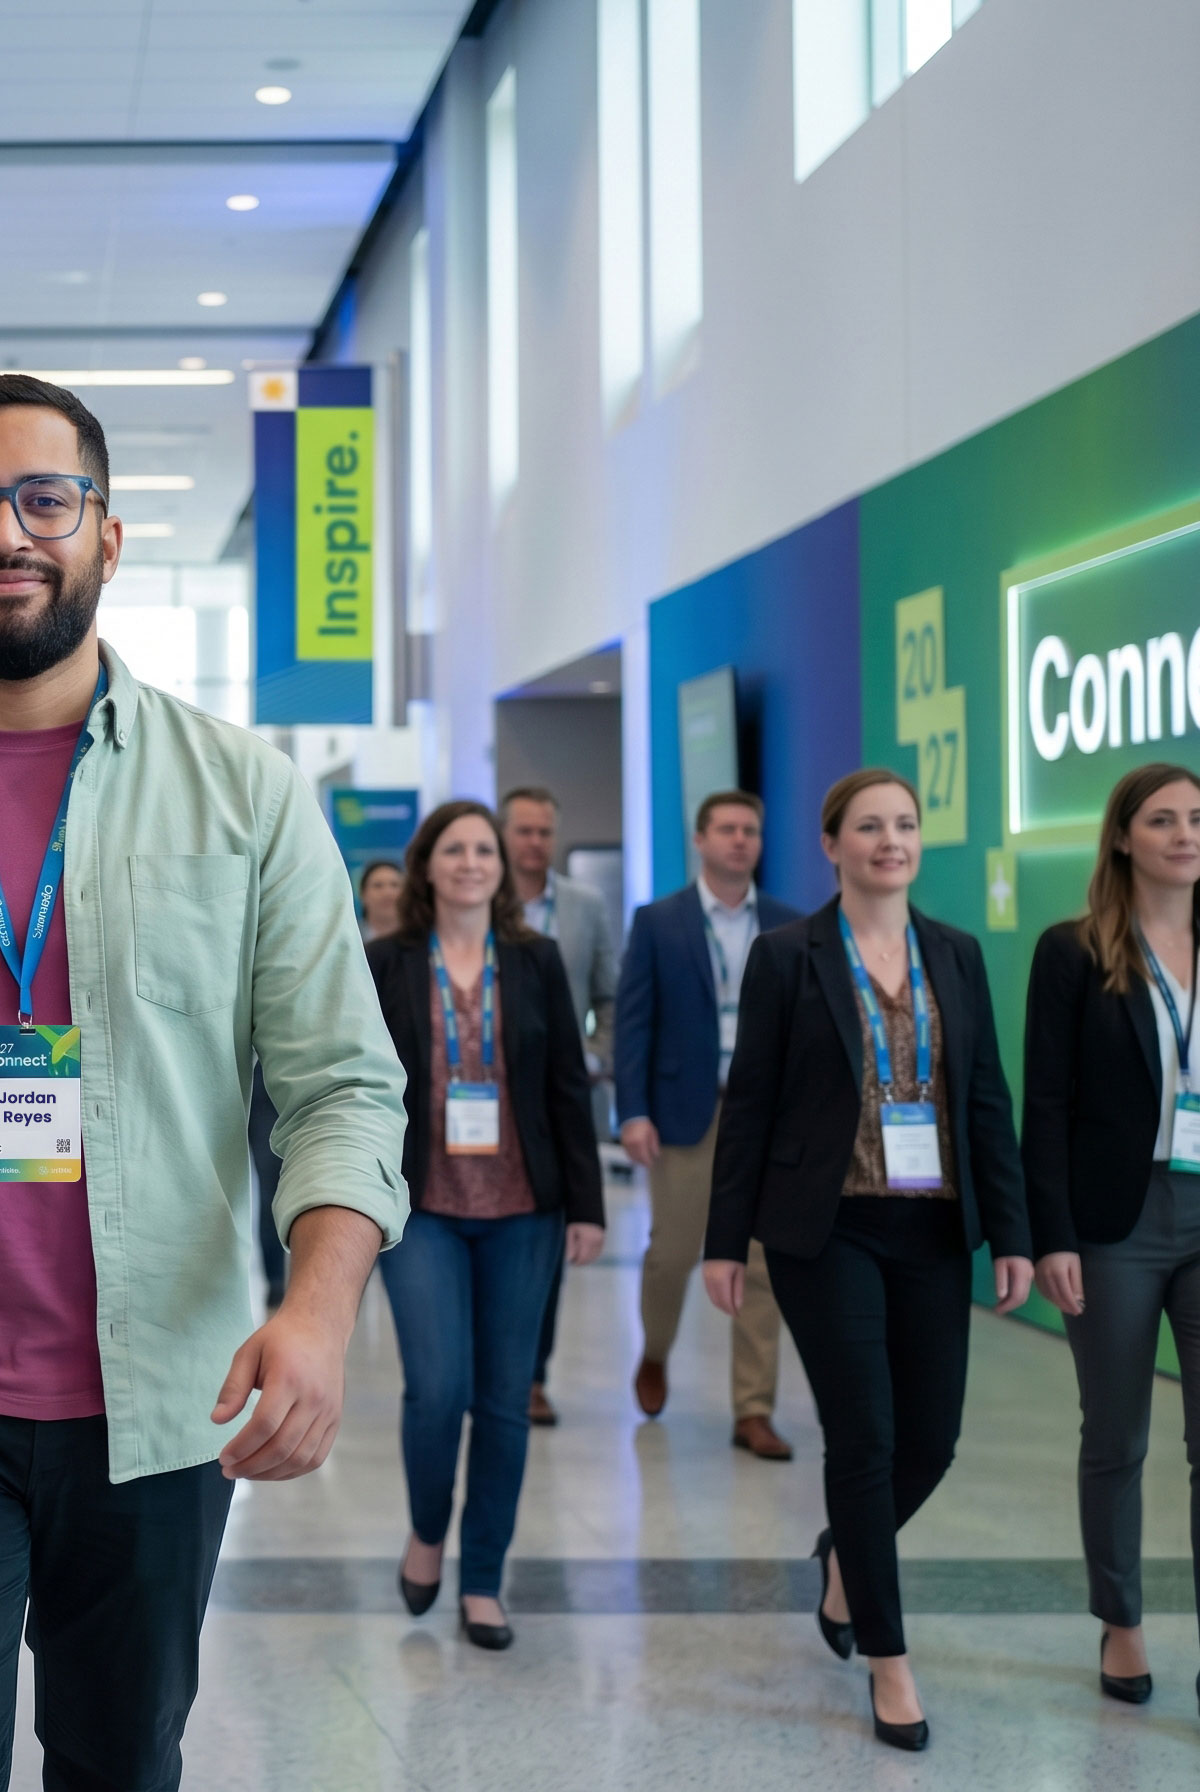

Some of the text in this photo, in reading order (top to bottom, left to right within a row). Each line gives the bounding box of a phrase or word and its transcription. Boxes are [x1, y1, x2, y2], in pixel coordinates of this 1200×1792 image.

[313, 431, 371, 637] Inspire.
[903, 622, 937, 701] 20
[926, 729, 959, 811] 27
[3, 1111, 52, 1127] Reyes
